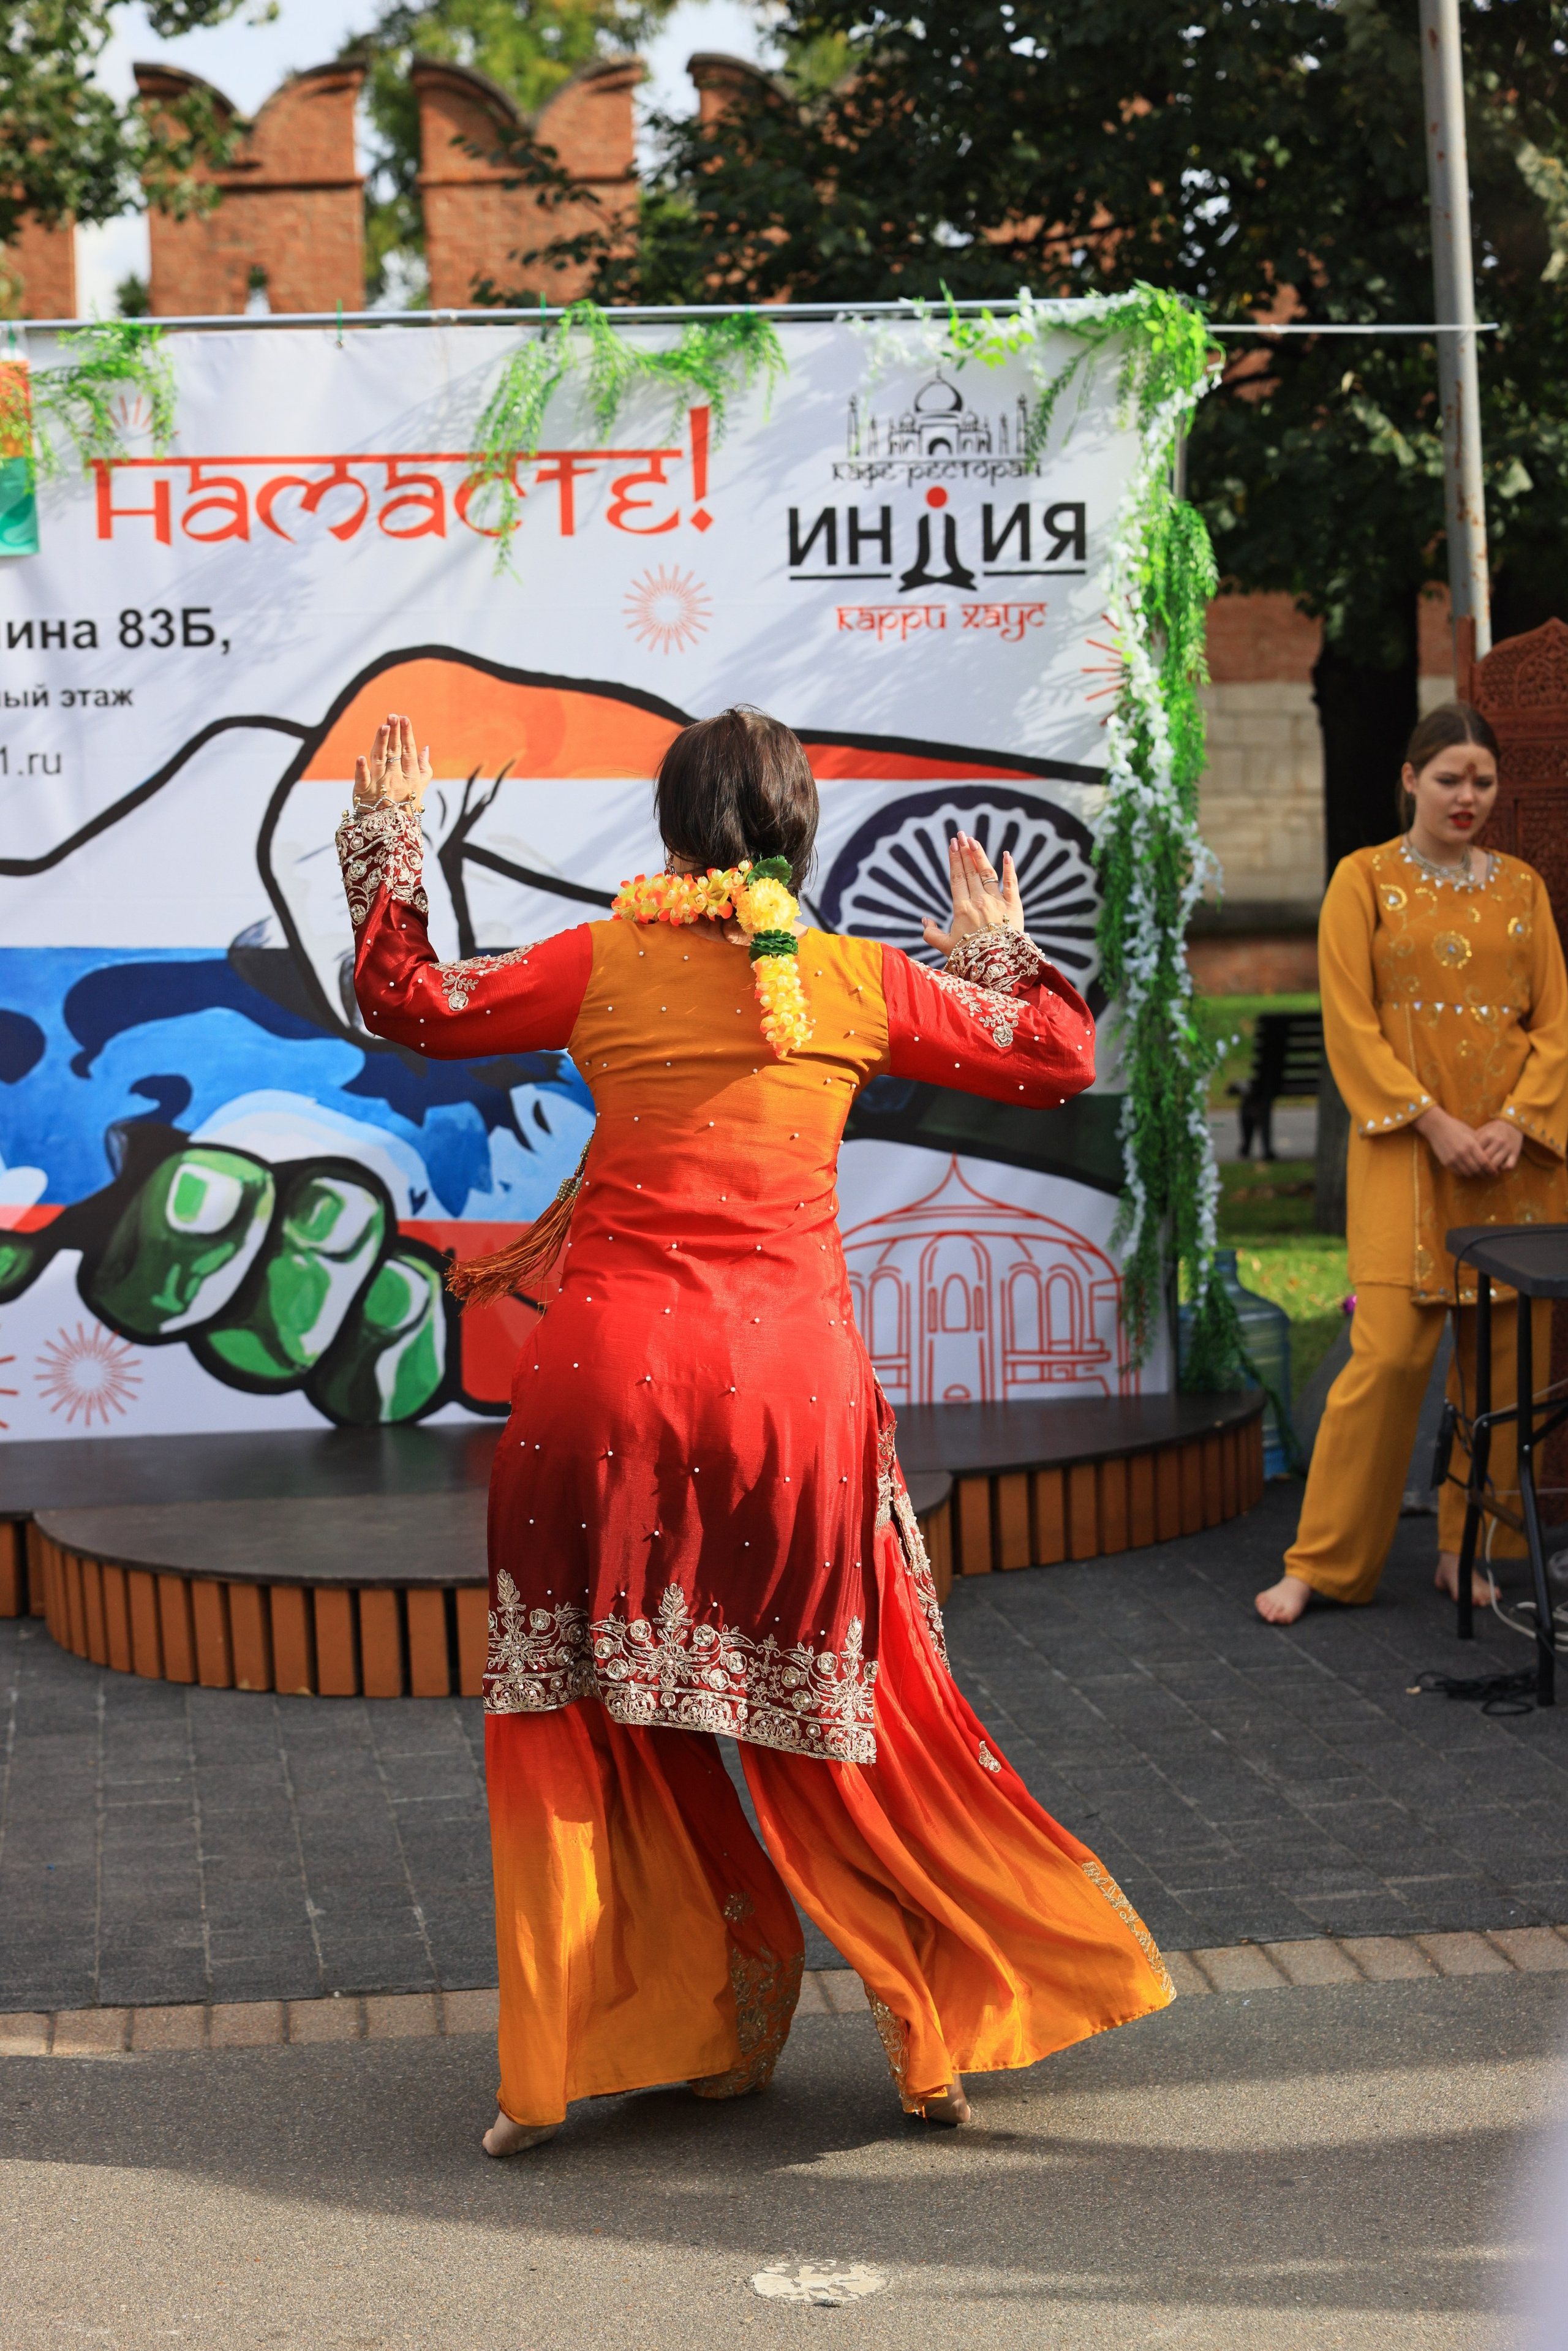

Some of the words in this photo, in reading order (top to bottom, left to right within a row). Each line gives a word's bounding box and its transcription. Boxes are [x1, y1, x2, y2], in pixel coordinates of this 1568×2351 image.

[788, 488, 1087, 592] ИНДИЯ
[119, 608, 230, 655] 83Б,
[60, 688, 133, 708] этаж
